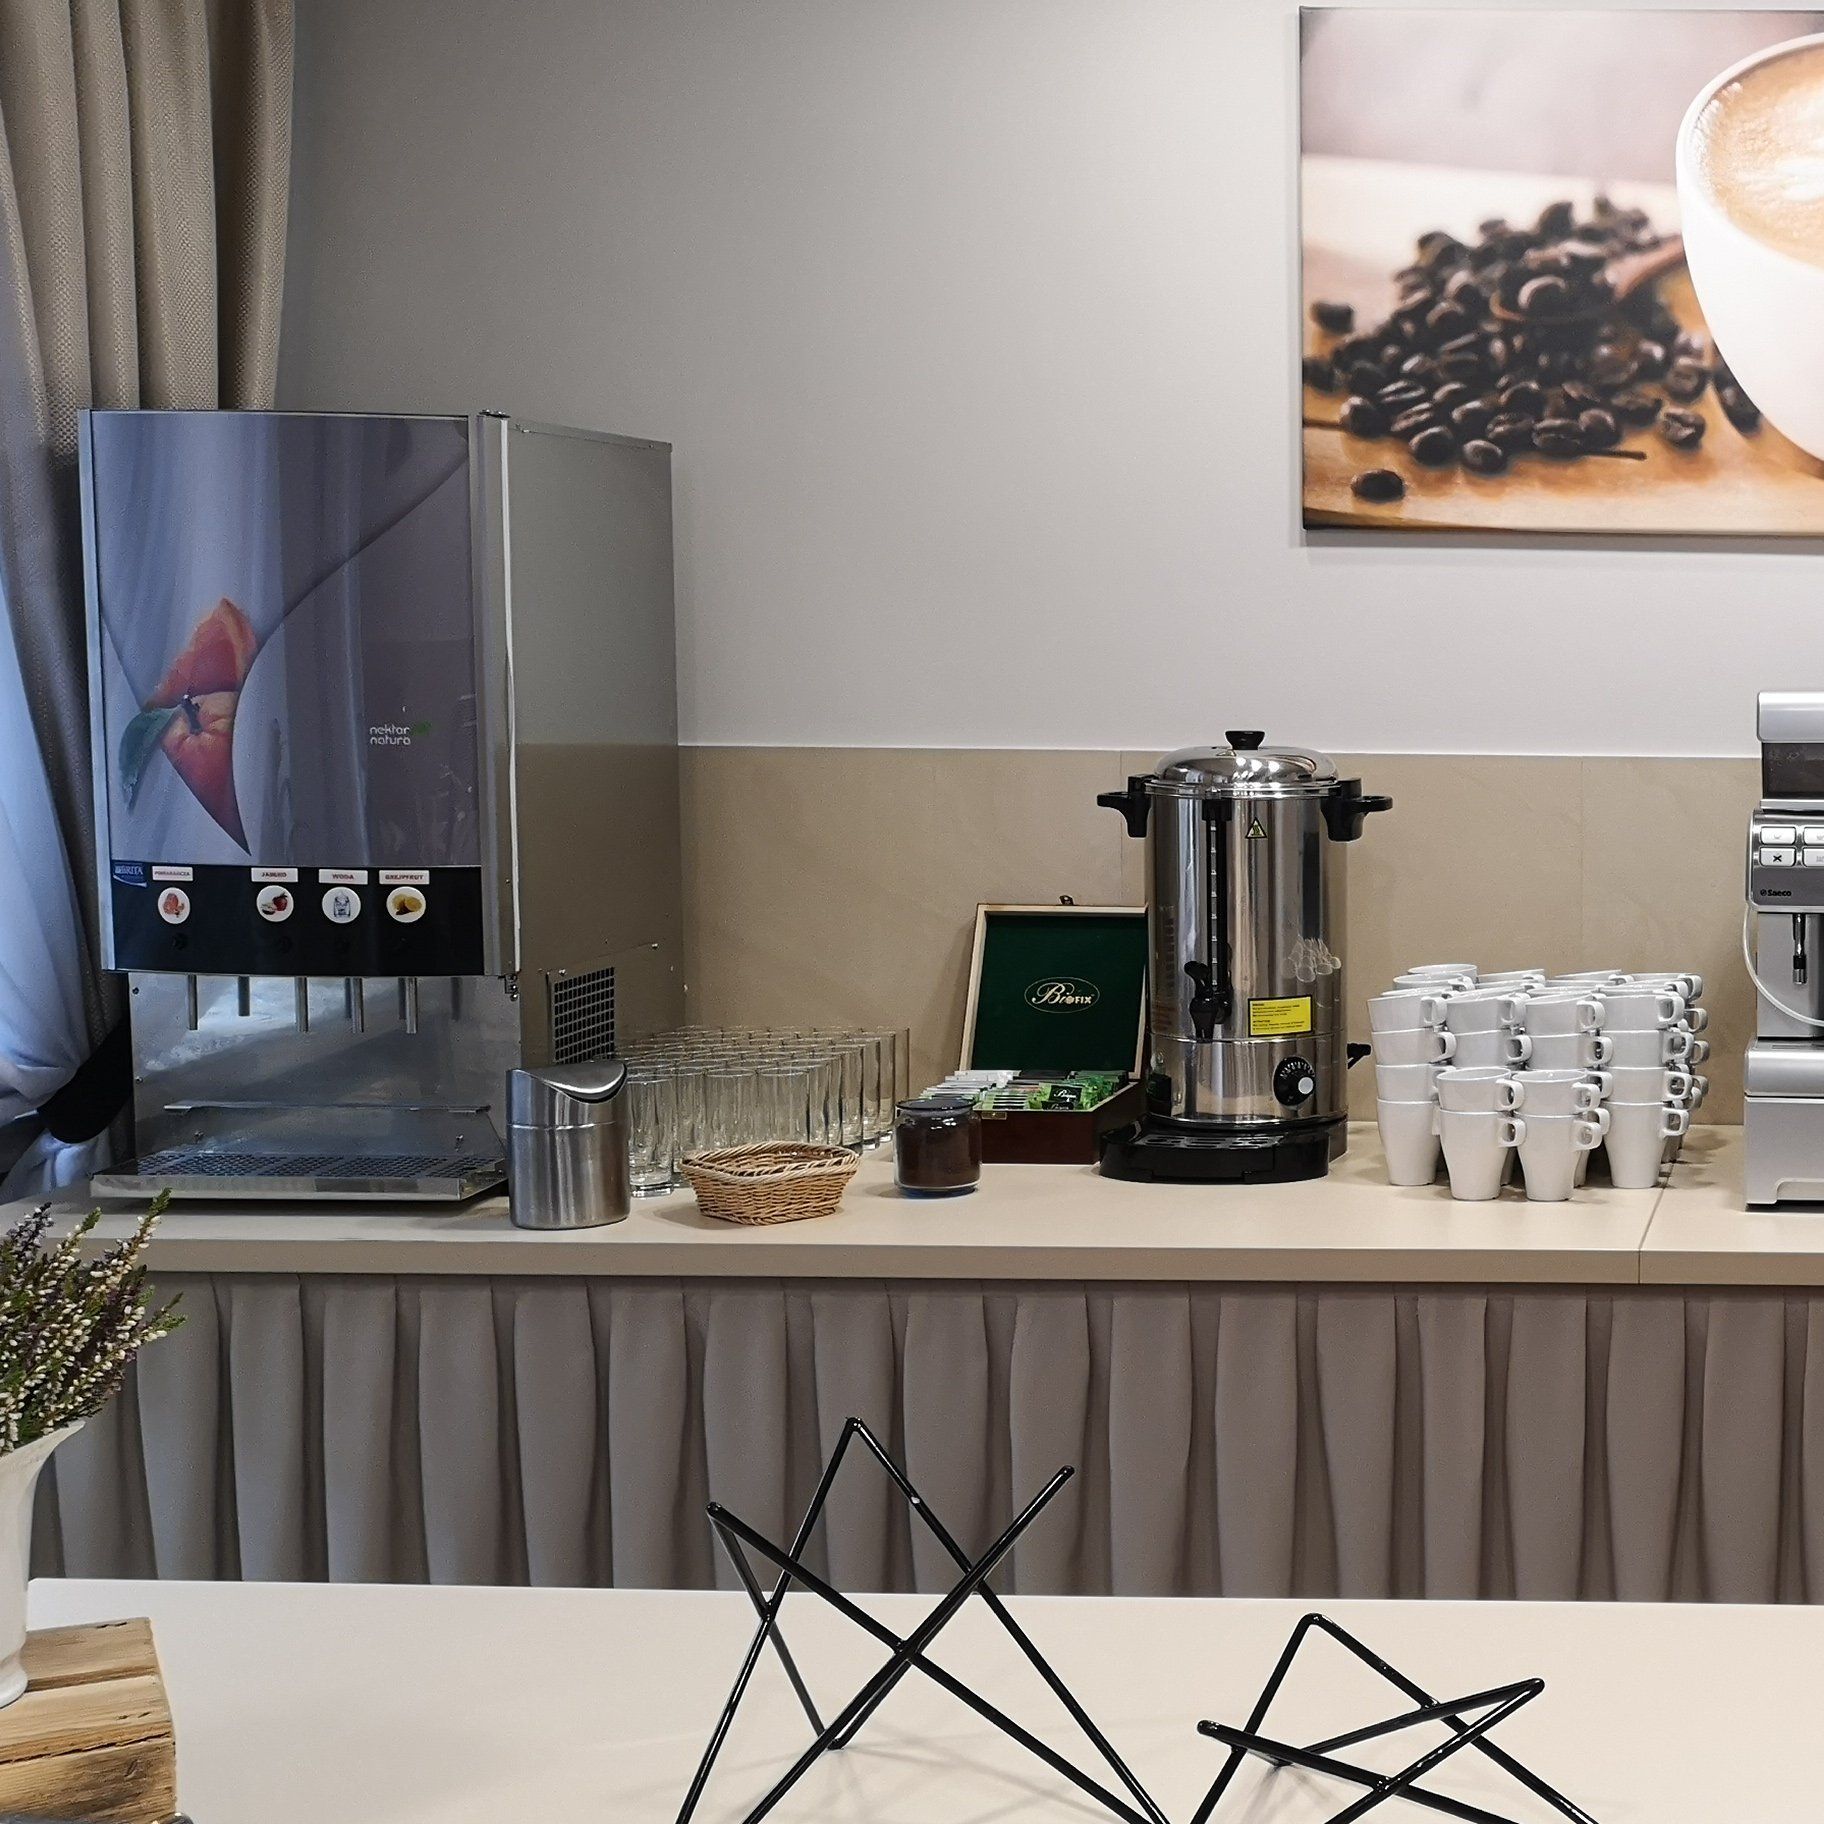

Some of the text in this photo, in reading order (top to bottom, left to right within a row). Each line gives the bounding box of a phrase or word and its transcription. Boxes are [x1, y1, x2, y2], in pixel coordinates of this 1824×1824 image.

[370, 724, 410, 735] nektar
[370, 735, 411, 745] natura
[1767, 889, 1792, 897] Saeco
